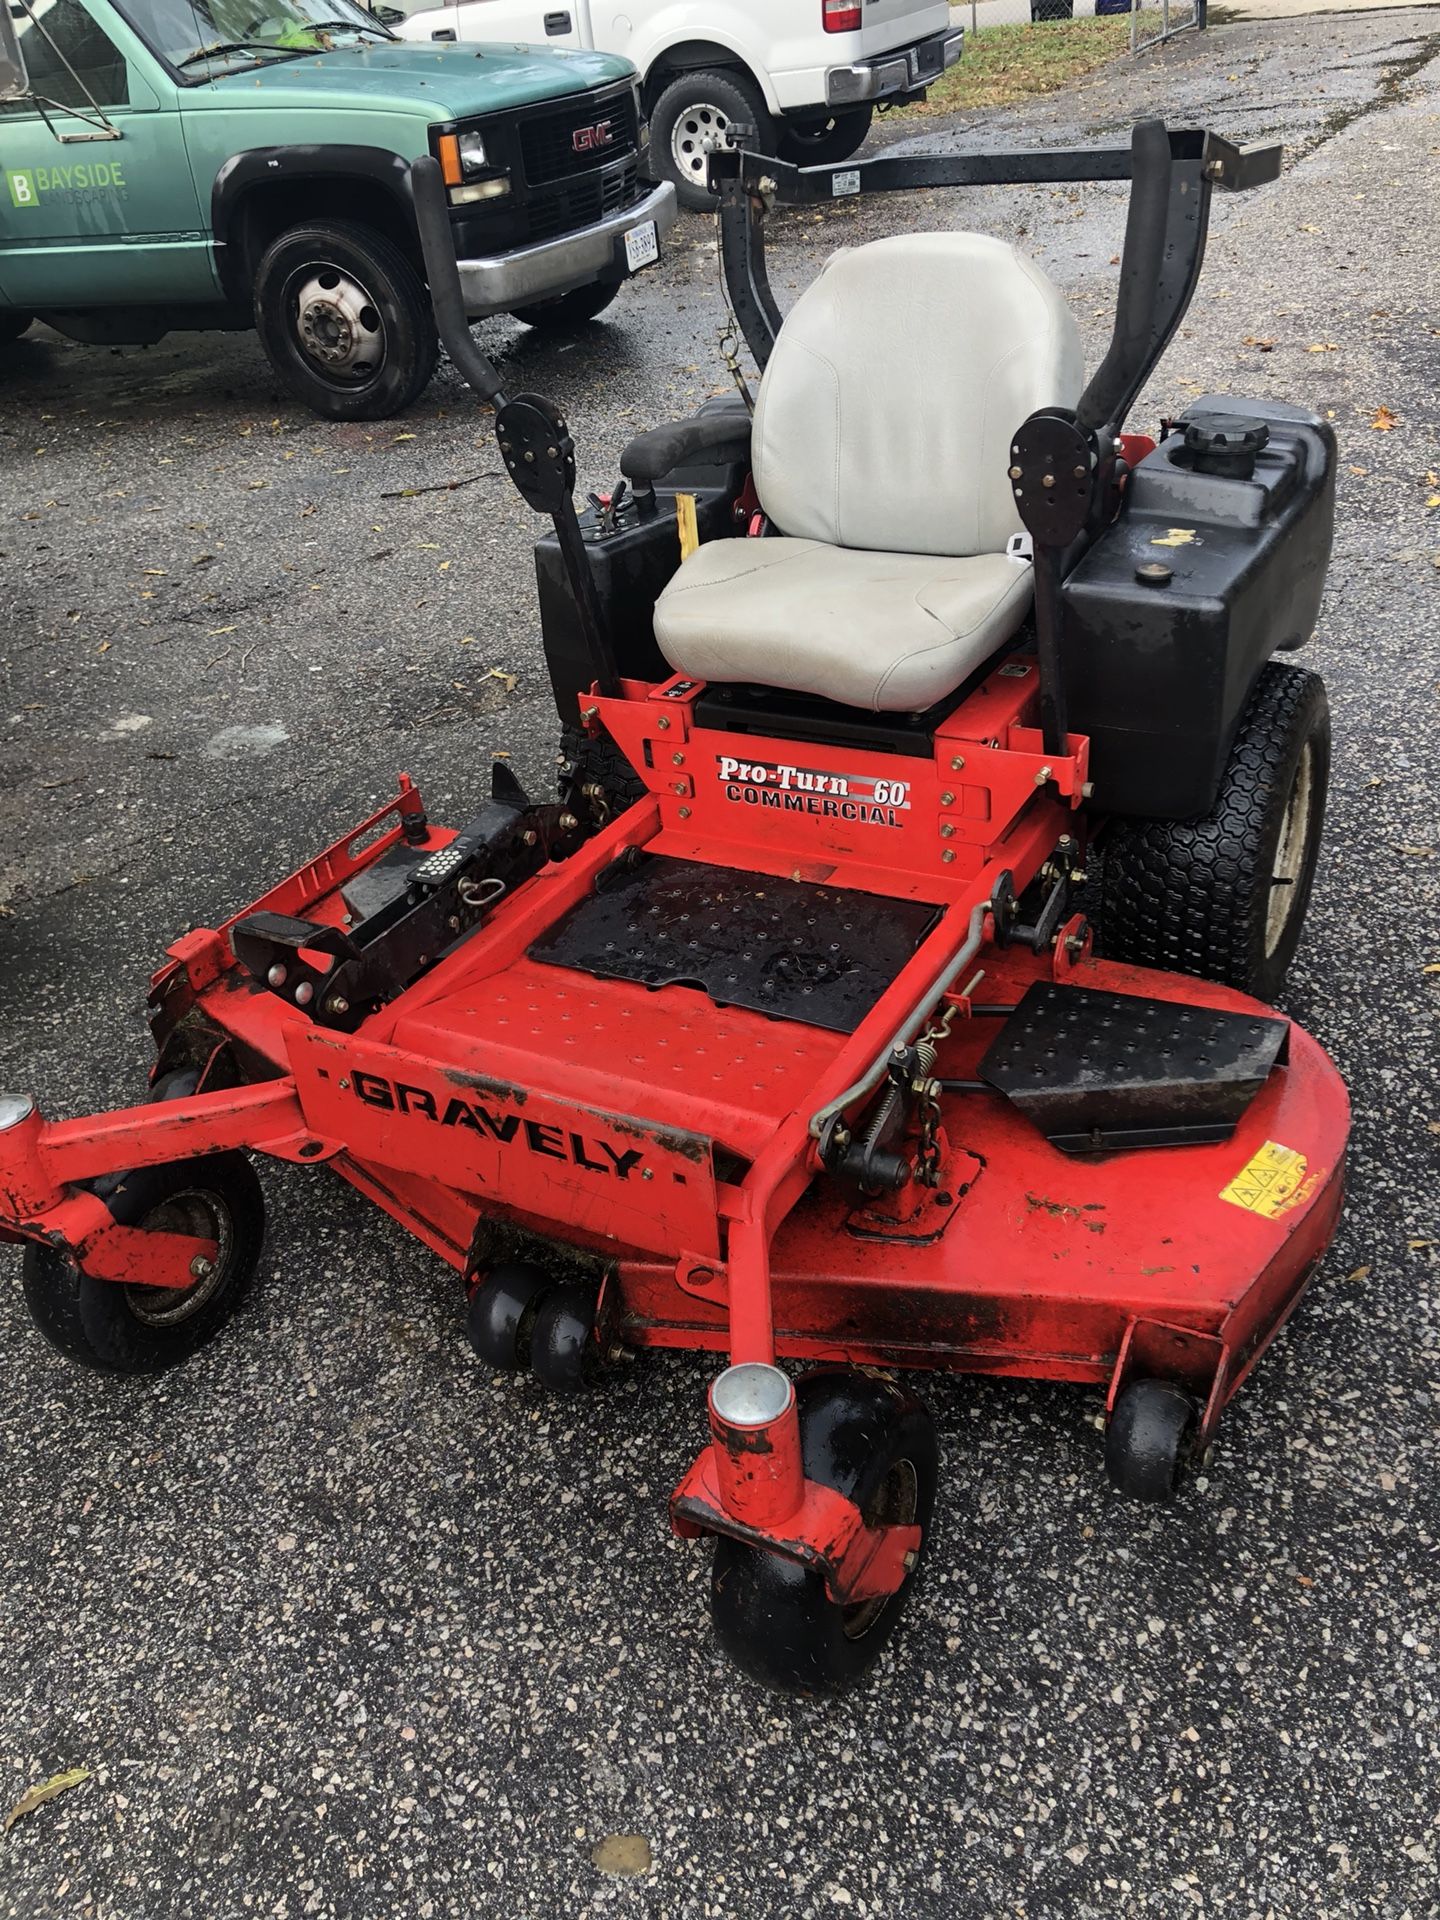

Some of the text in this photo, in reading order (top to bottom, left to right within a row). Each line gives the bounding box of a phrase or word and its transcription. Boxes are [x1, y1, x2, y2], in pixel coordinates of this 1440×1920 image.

[572, 120, 612, 151] GMC
[12, 162, 126, 202] B BAYSIDE
[718, 756, 906, 806] Pro-Turn 60
[725, 784, 904, 828] COMMERCIAL
[350, 1069, 644, 1180] GRAVELY
